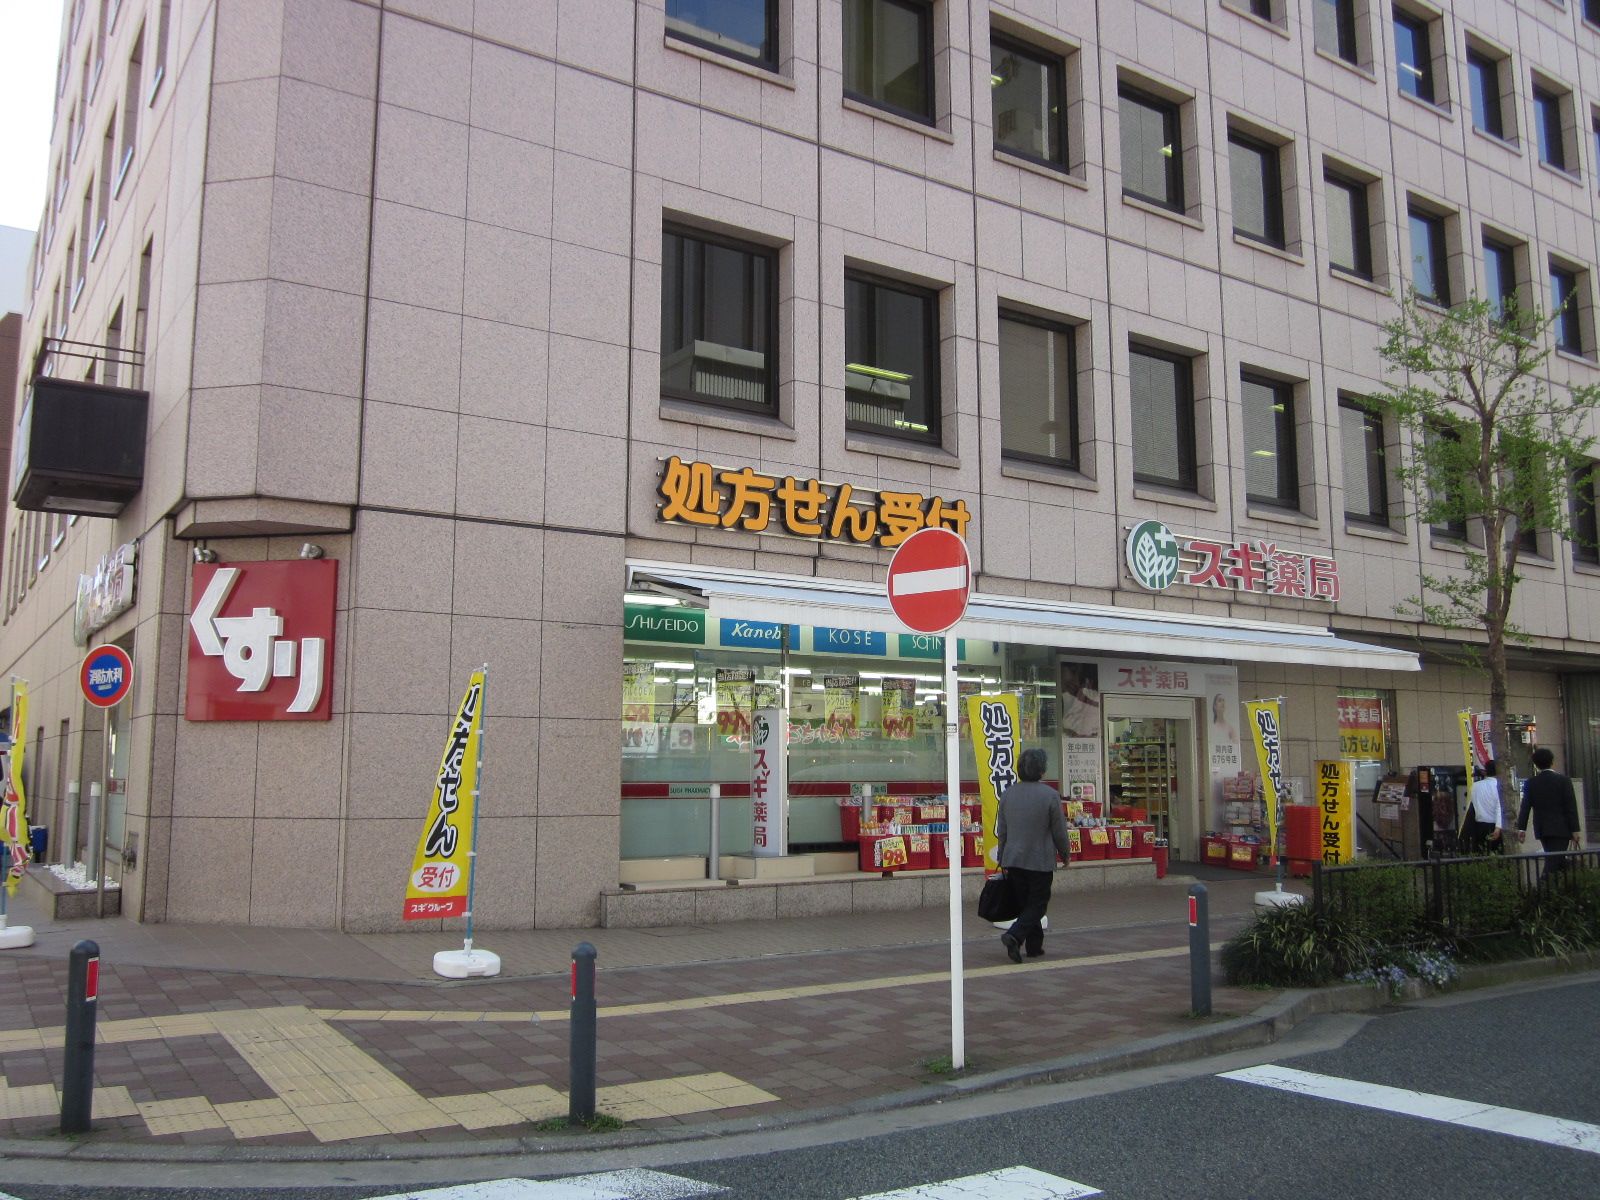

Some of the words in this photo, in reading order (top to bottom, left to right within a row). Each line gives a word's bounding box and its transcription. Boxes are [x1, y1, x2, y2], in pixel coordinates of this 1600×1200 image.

[659, 456, 971, 547] 処方せん受付
[1184, 540, 1340, 601] スギ薬局
[625, 614, 699, 633] SHISEIDO
[731, 622, 785, 640] Kaneb
[190, 568, 325, 713] くすり
[89, 667, 123, 685] 消防水利
[1118, 665, 1189, 690] スギ薬局
[753, 748, 771, 848] スギ薬局
[1321, 763, 1341, 865] 処方せん受付
[883, 848, 905, 866] 98
[417, 866, 454, 888] 受付
[411, 902, 453, 913] スギグループ
